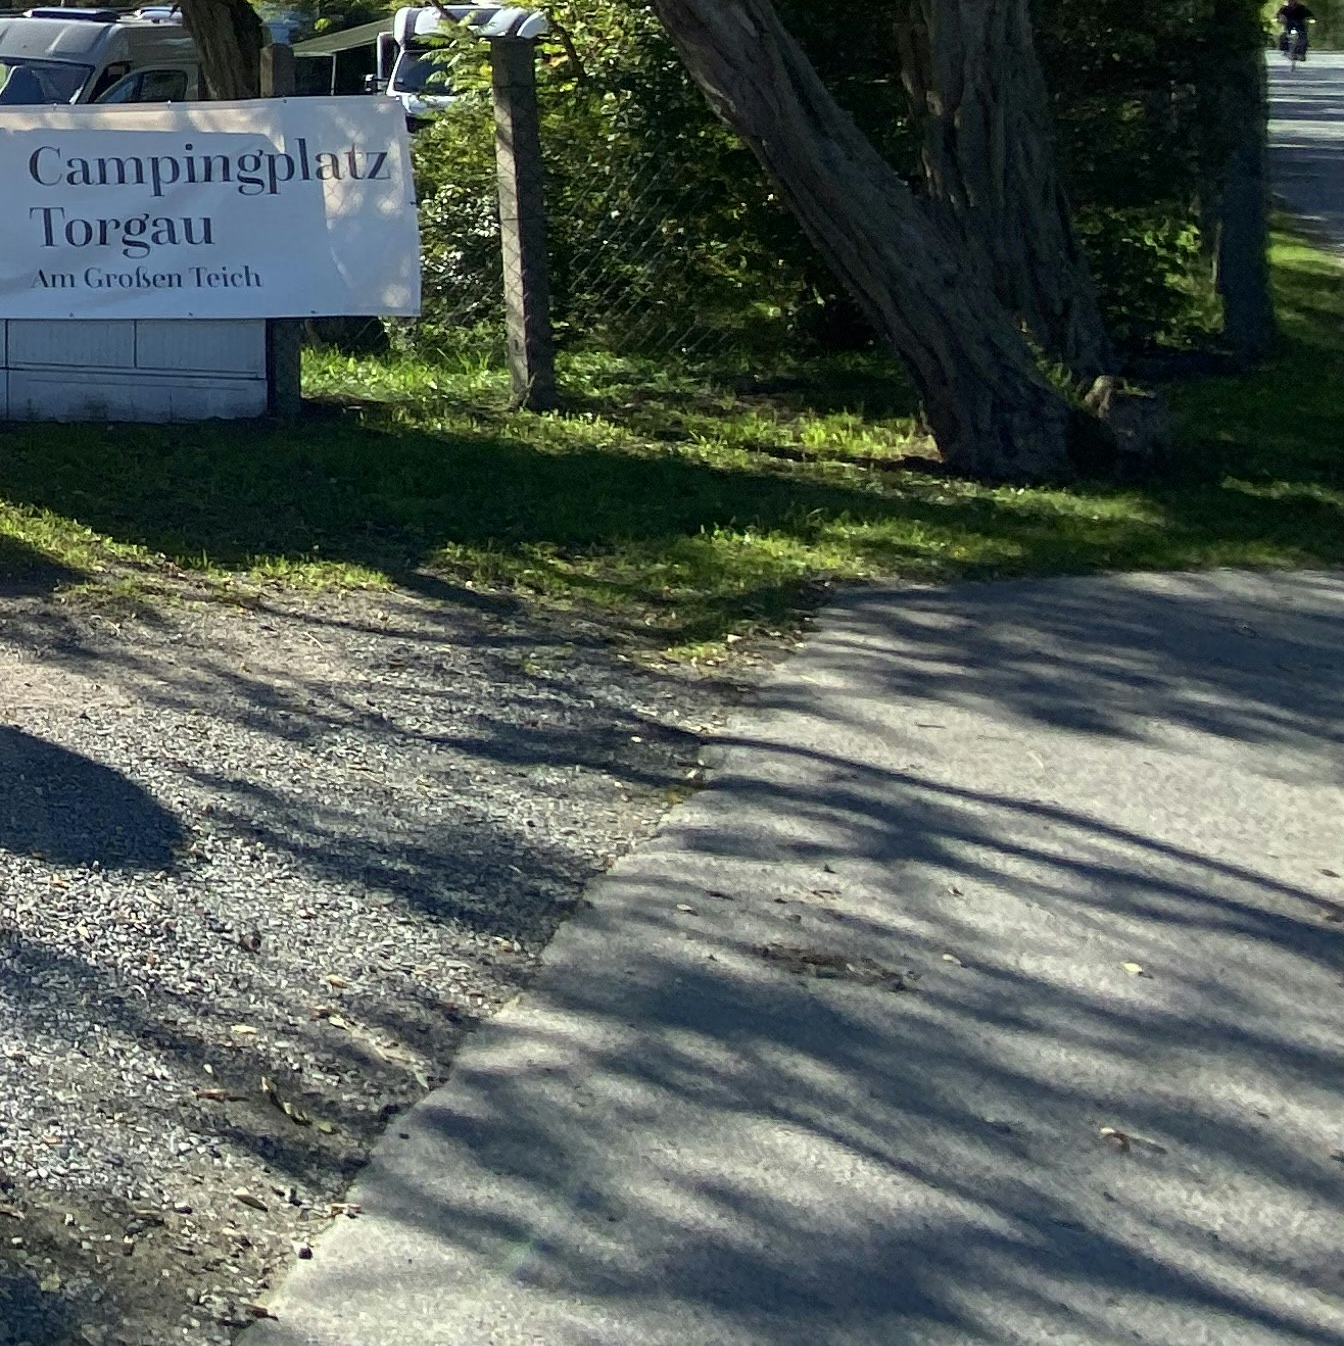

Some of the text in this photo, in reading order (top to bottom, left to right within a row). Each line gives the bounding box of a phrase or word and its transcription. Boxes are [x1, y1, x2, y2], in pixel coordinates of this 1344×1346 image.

[29, 137, 392, 197] Campingplatz
[29, 206, 215, 259] Torgau
[31, 264, 262, 290] Am Großen Teich
